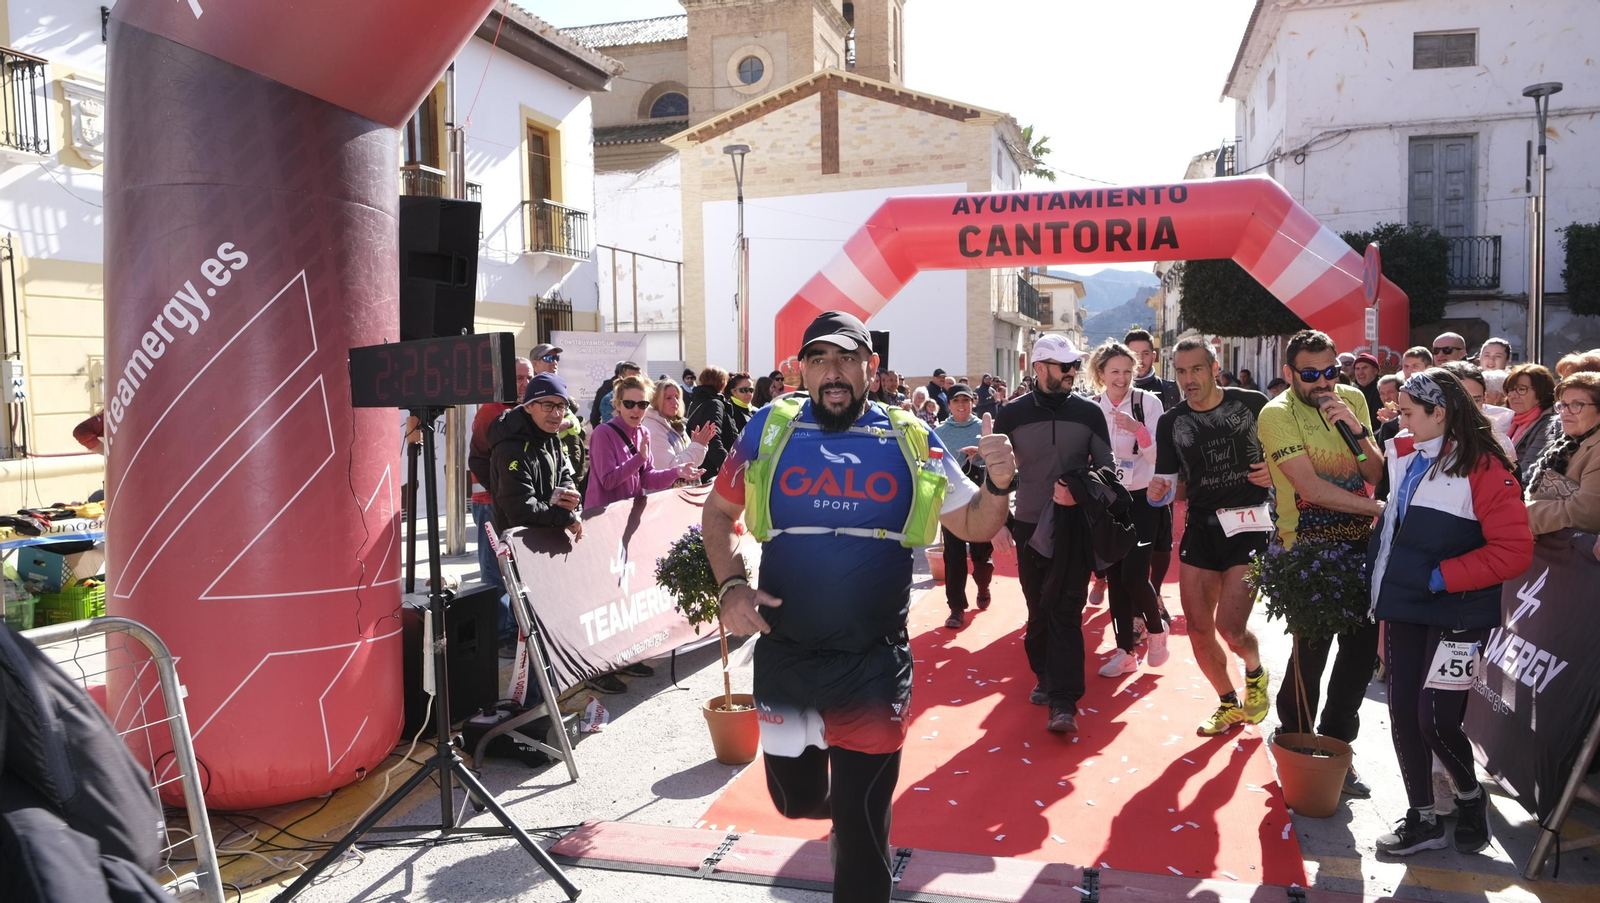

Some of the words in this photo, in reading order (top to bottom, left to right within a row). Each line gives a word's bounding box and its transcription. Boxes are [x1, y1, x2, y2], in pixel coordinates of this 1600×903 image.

[952, 184, 1188, 215] AYUNTAMIENTO
[958, 215, 1180, 258] CANTORIA
[1207, 438, 1220, 448] LIFE
[1206, 445, 1231, 464] Trail
[1220, 462, 1231, 470] LIFE
[779, 465, 898, 503] GALO
[813, 499, 860, 511] SPORT
[1235, 509, 1256, 523] 71
[579, 584, 678, 646] TEAMERG
